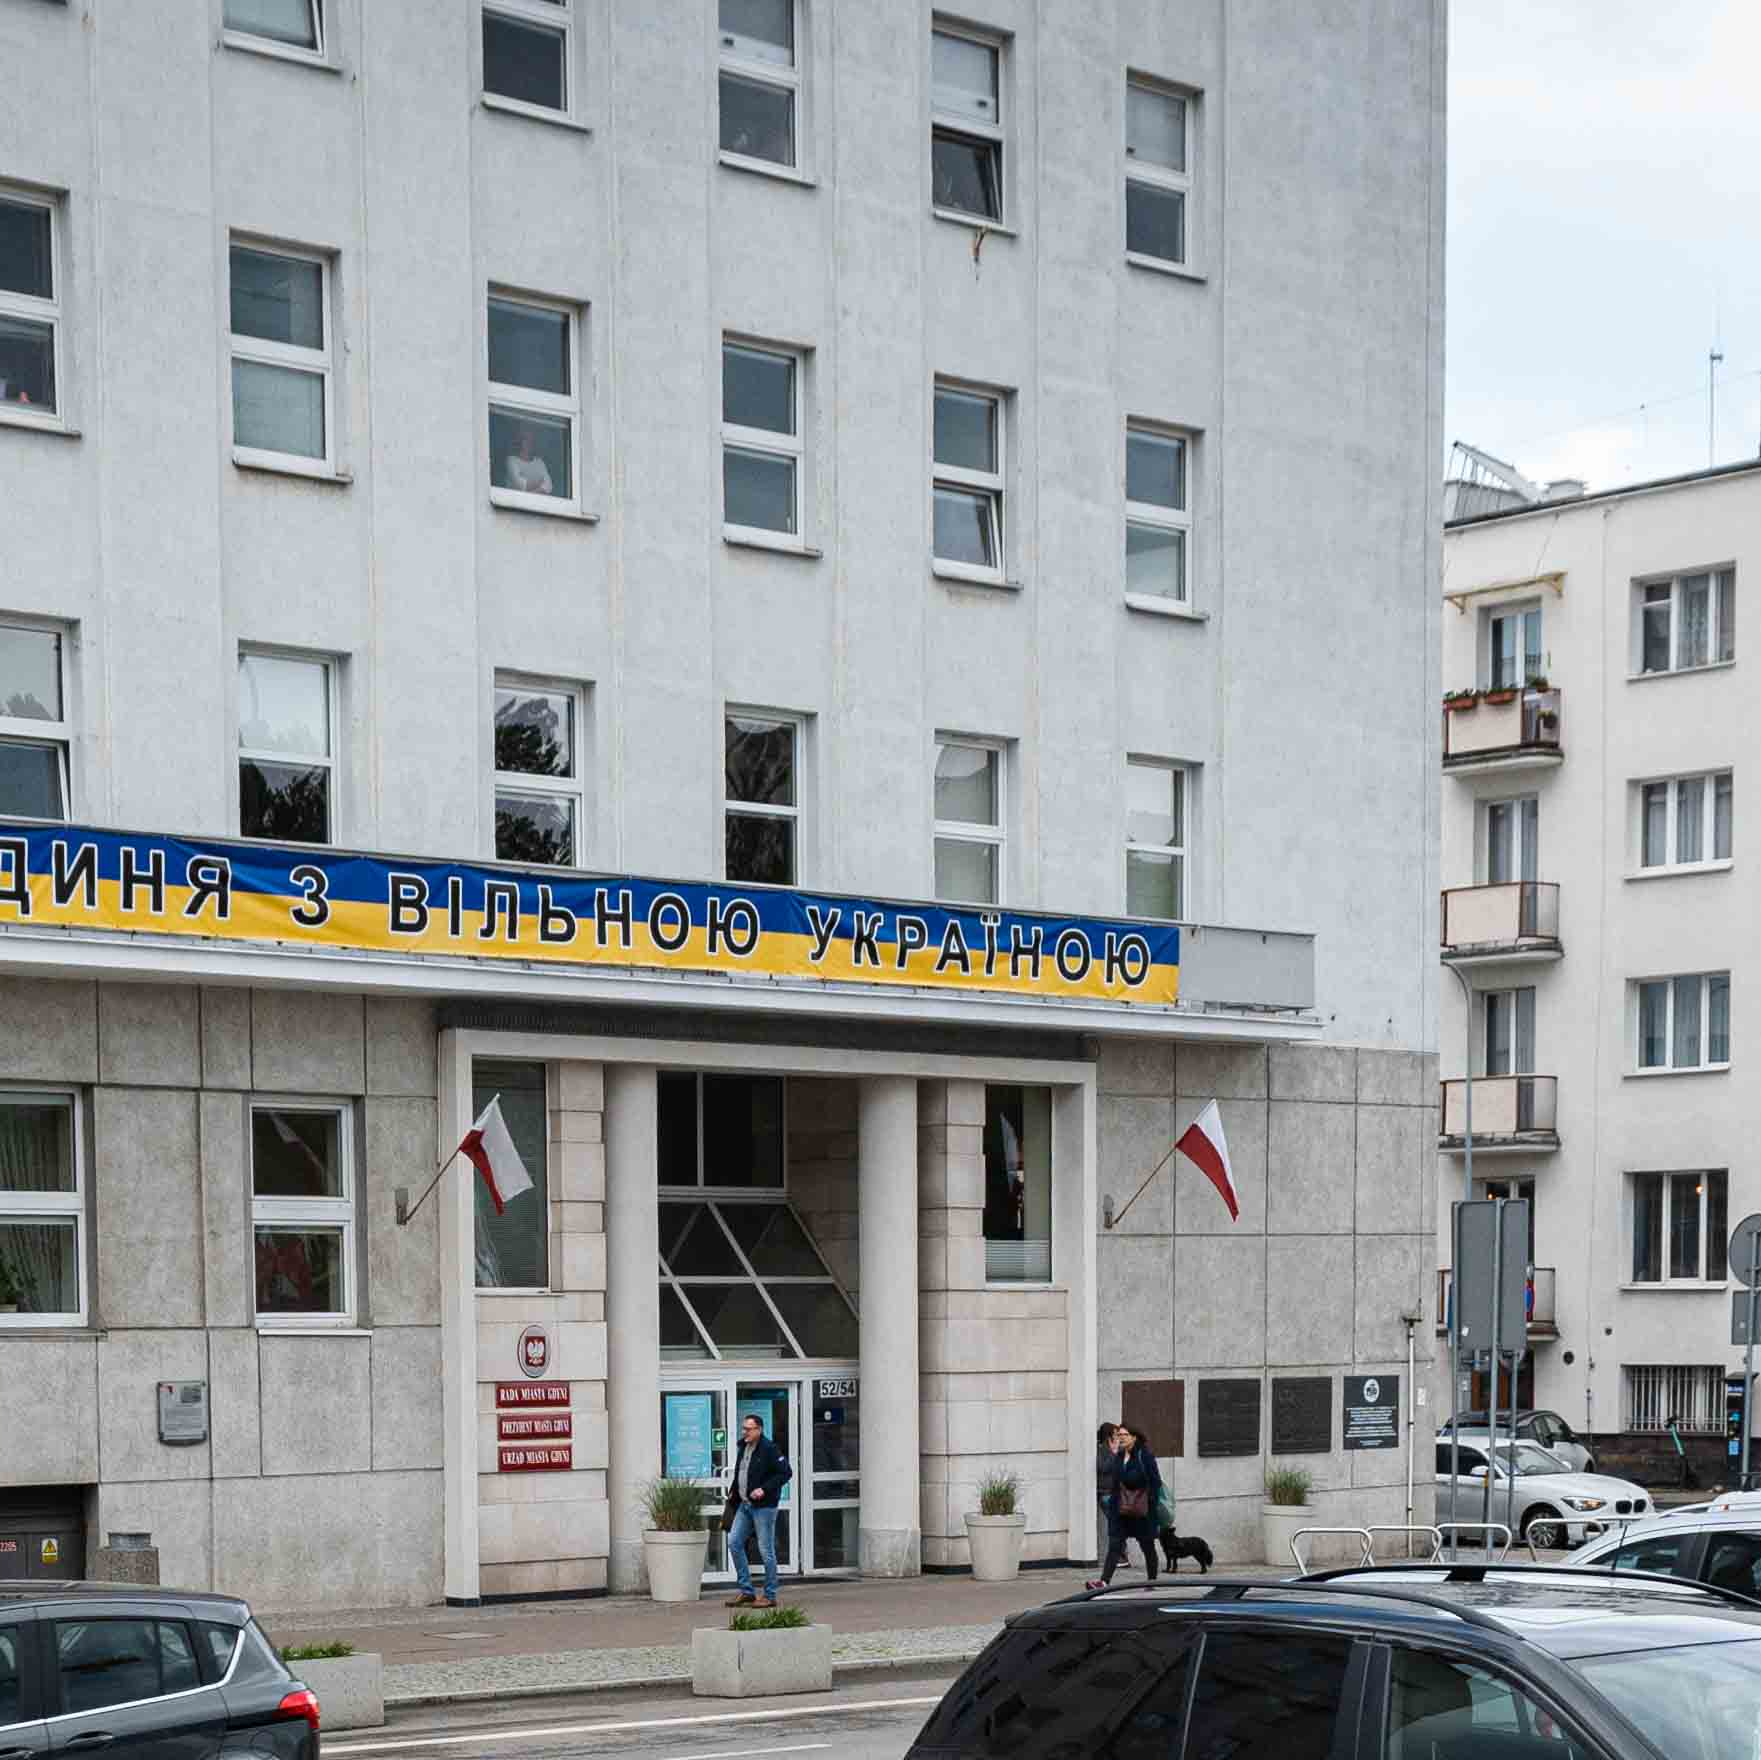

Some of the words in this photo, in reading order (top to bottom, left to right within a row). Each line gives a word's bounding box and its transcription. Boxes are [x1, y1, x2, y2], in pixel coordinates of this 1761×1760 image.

[288, 865, 331, 928] З
[388, 872, 761, 957] ВІЛЬНОЮ
[807, 906, 1151, 987] УКРАЇНОЮ
[500, 1388, 519, 1401] RADA
[521, 1387, 546, 1401] MIASTA
[547, 1387, 568, 1401] GDYNI
[822, 1381, 855, 1397] 52/54
[526, 1451, 550, 1464] MIASTA
